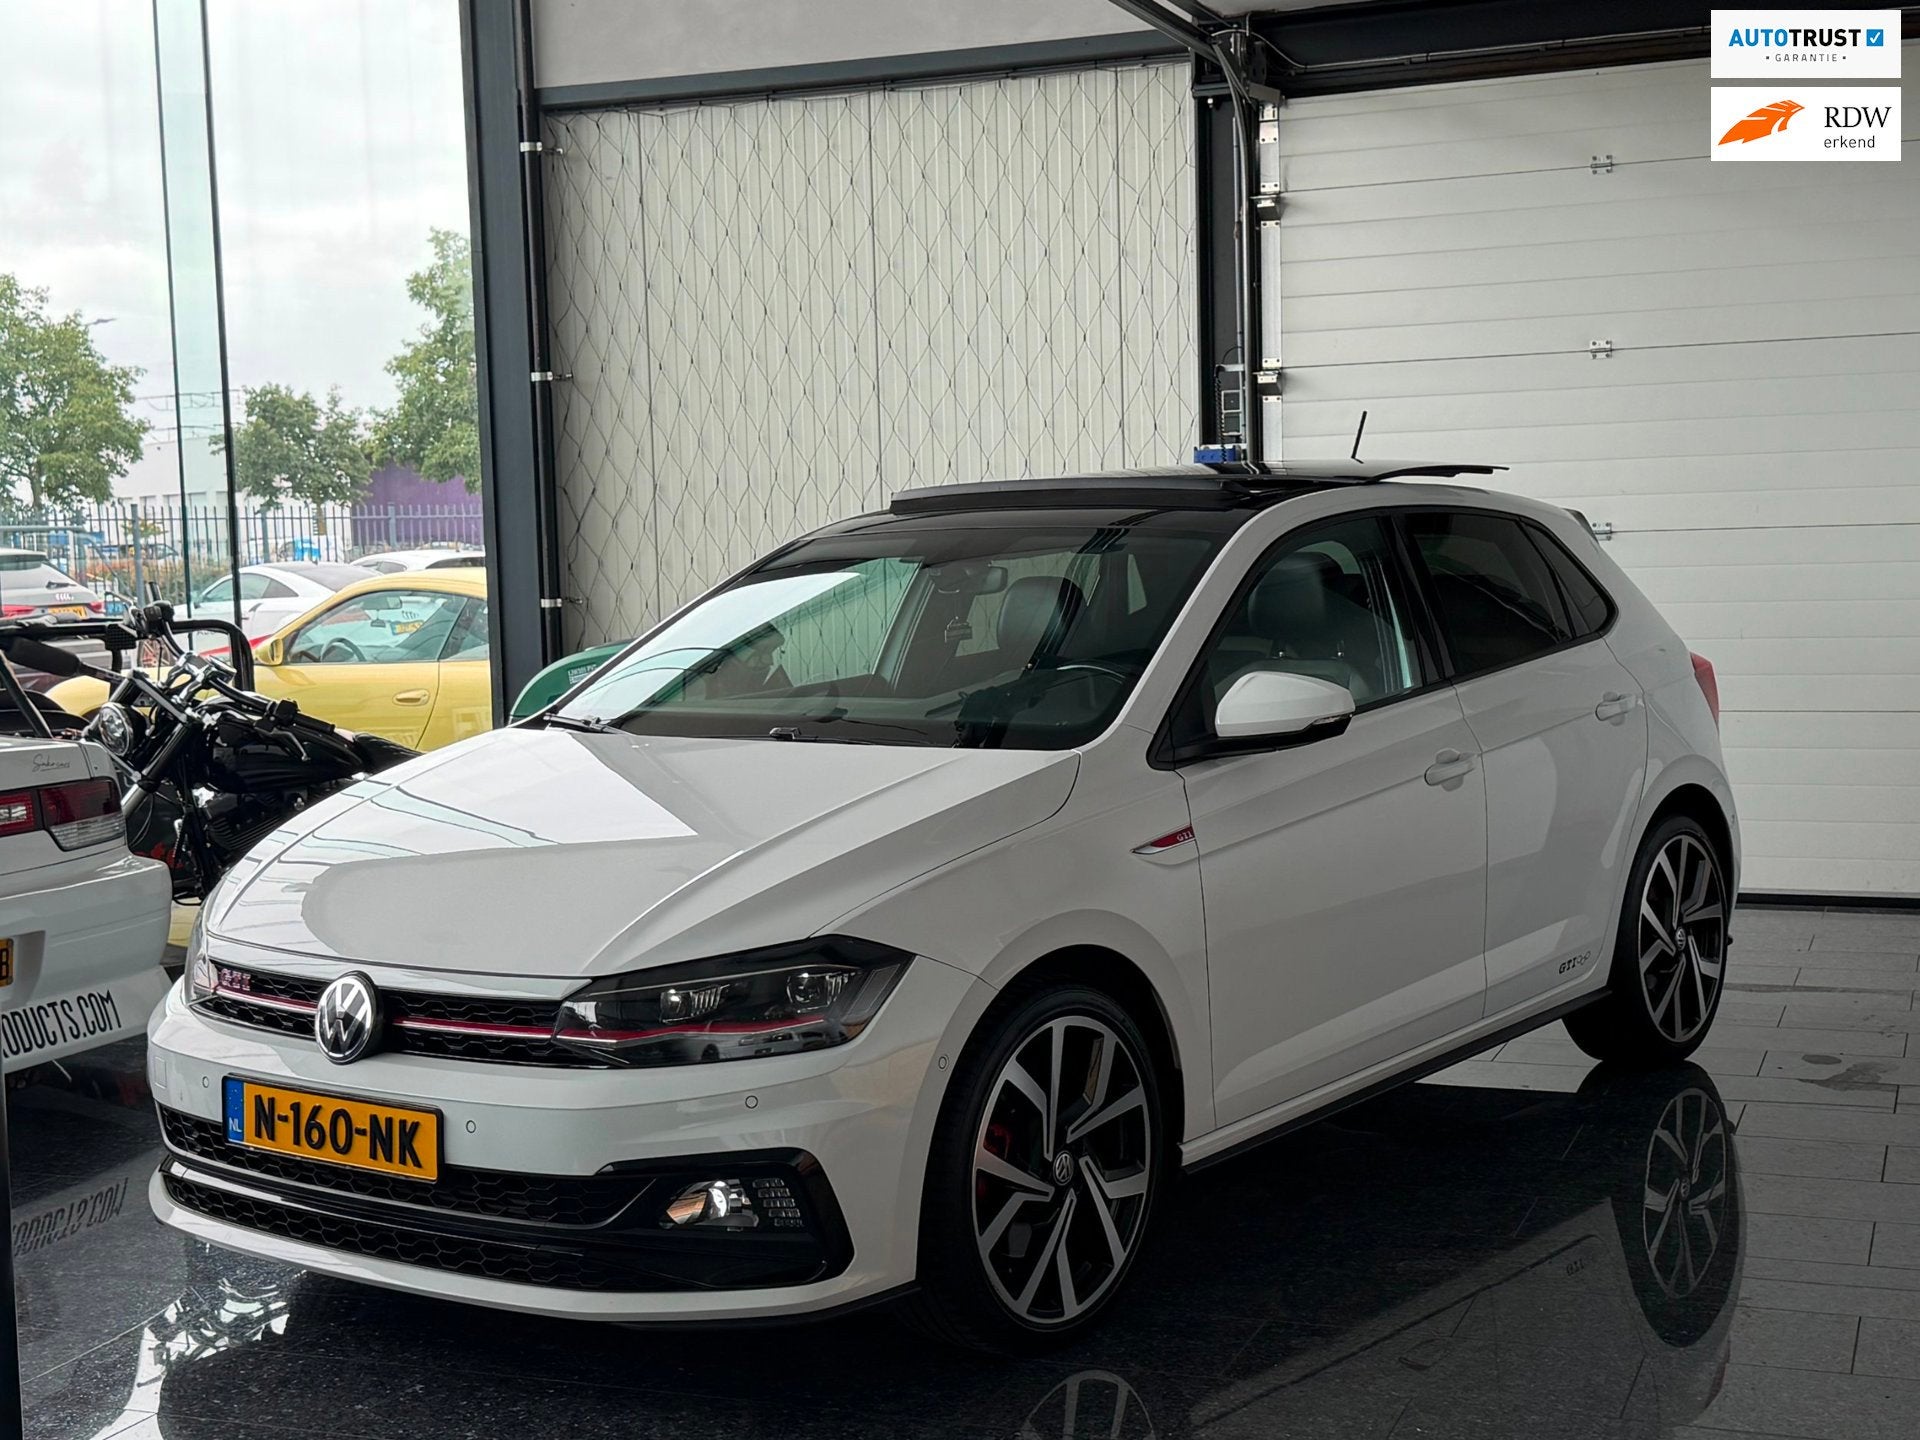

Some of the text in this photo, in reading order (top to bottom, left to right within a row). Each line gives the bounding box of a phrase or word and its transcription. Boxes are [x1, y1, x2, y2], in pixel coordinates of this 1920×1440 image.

[1559, 957, 1577, 974] GTI
[220, 968, 251, 991] GTI
[1, 989, 122, 1058] ODUCTS.COM
[228, 1117, 242, 1133] NL
[254, 1094, 423, 1168] N-160-NK
